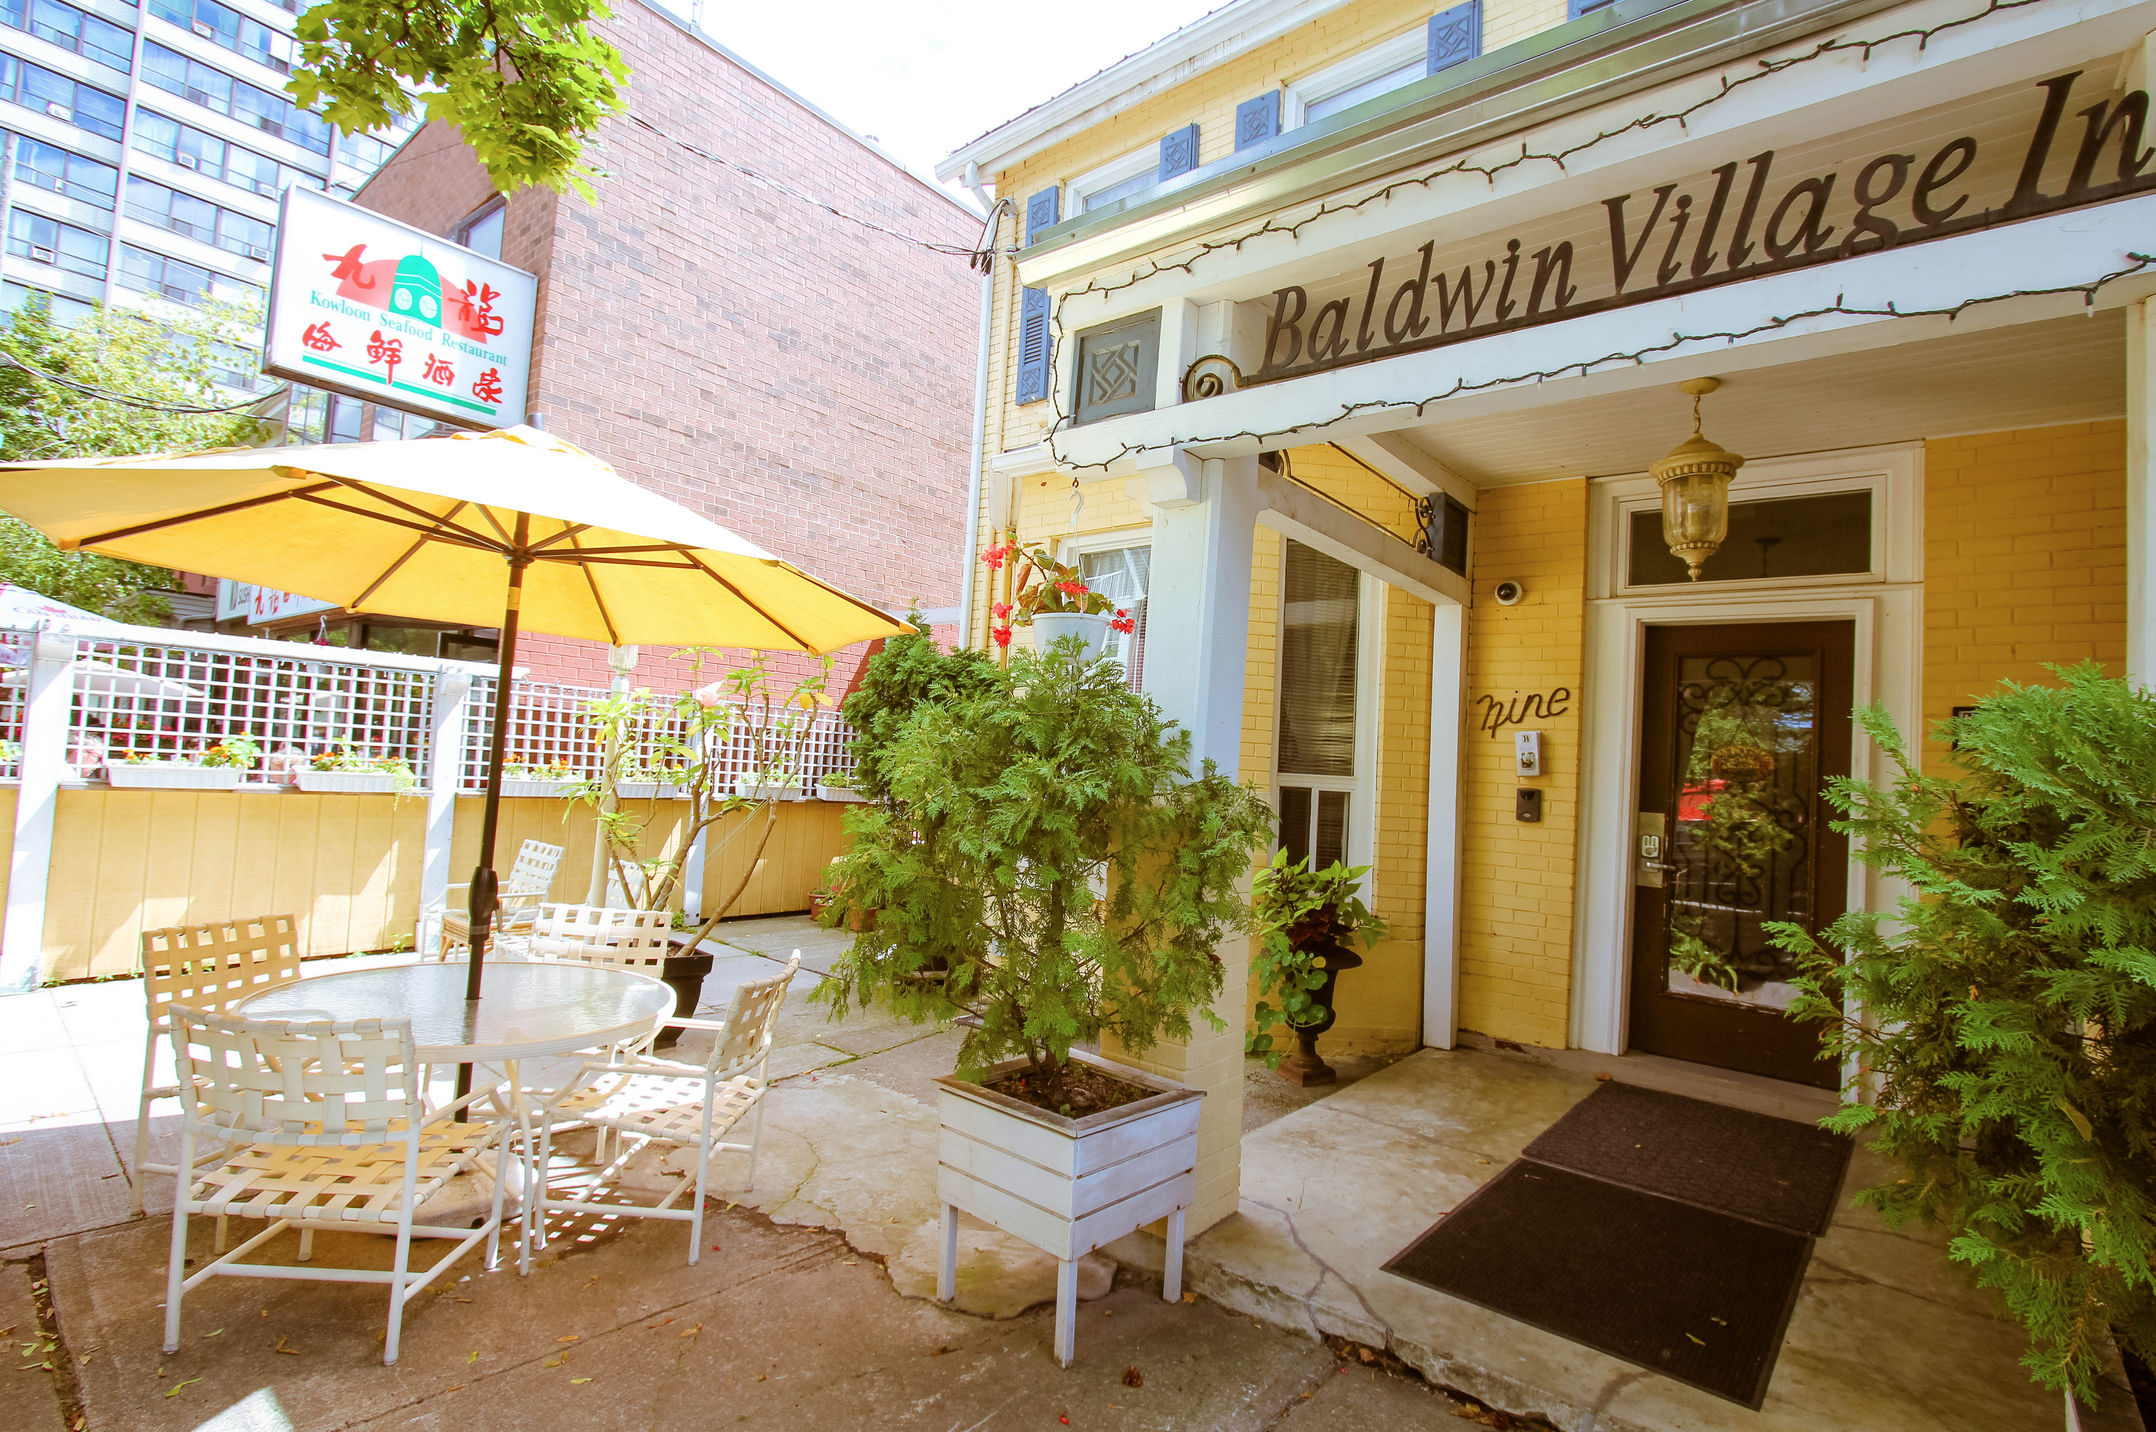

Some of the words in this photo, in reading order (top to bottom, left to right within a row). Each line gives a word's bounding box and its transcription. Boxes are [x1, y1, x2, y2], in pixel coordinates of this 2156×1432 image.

[1258, 238, 1577, 371] Baldwin
[1601, 136, 1977, 294] Village
[310, 290, 371, 322] Kowloon
[379, 312, 433, 341] Seafood
[441, 332, 508, 366] Restaurant
[1476, 687, 1570, 738] nine
